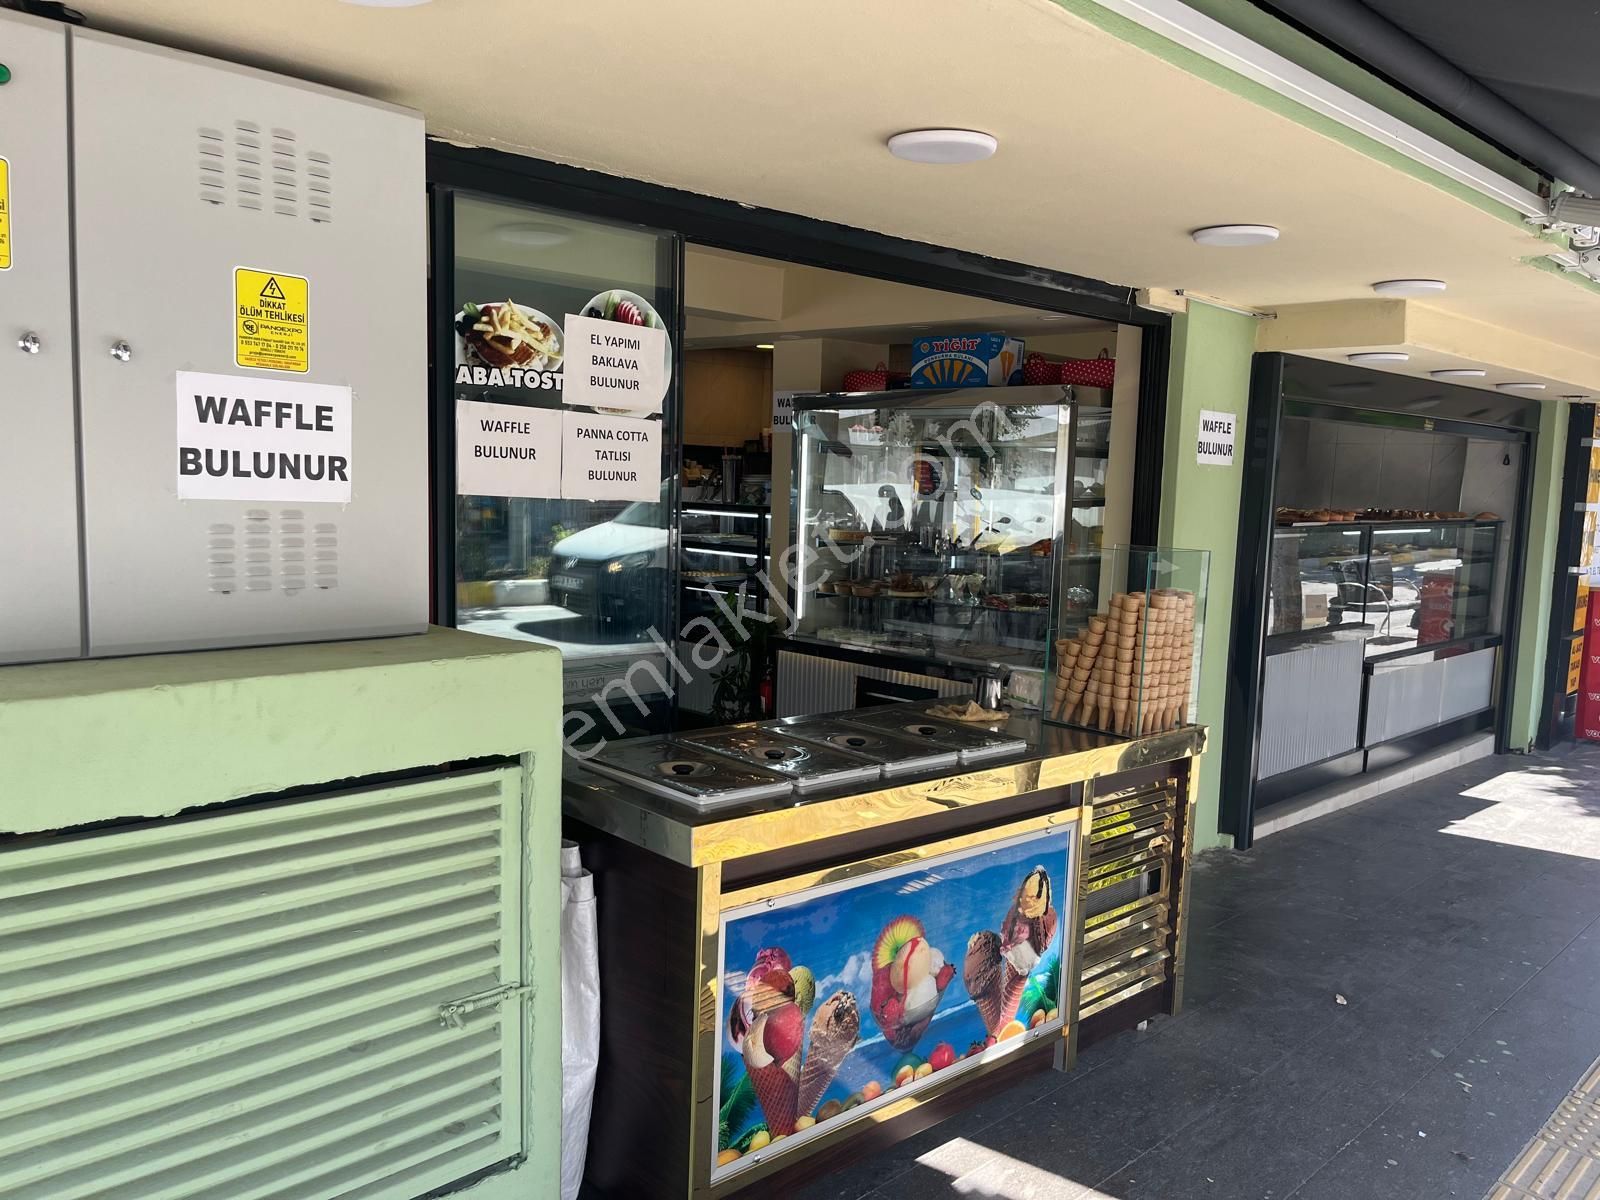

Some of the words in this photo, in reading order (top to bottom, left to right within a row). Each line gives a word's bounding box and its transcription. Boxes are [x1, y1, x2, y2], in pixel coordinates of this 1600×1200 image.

[260, 298, 286, 311] DİKKAT
[240, 305, 262, 317] ÖLÜM
[265, 310, 305, 323] TEHLİKESİ
[590, 334, 602, 346] EL
[605, 335, 640, 350] YAPIMI
[592, 355, 639, 371] BAKLAVA
[511, 369, 563, 390] TOST
[590, 375, 640, 391] BULUNUR
[194, 395, 334, 432] WAFFLE
[481, 419, 530, 435] WAFFLE
[577, 427, 613, 441] PANNA
[616, 430, 648, 442] COTTA
[1203, 419, 1232, 434] WAFFLE
[474, 445, 536, 461] BULUNUR
[595, 450, 630, 462] TATLISI
[1197, 441, 1233, 456] BULUNUR
[179, 447, 348, 482] BULUNUR
[588, 470, 637, 482] BULUNUR
